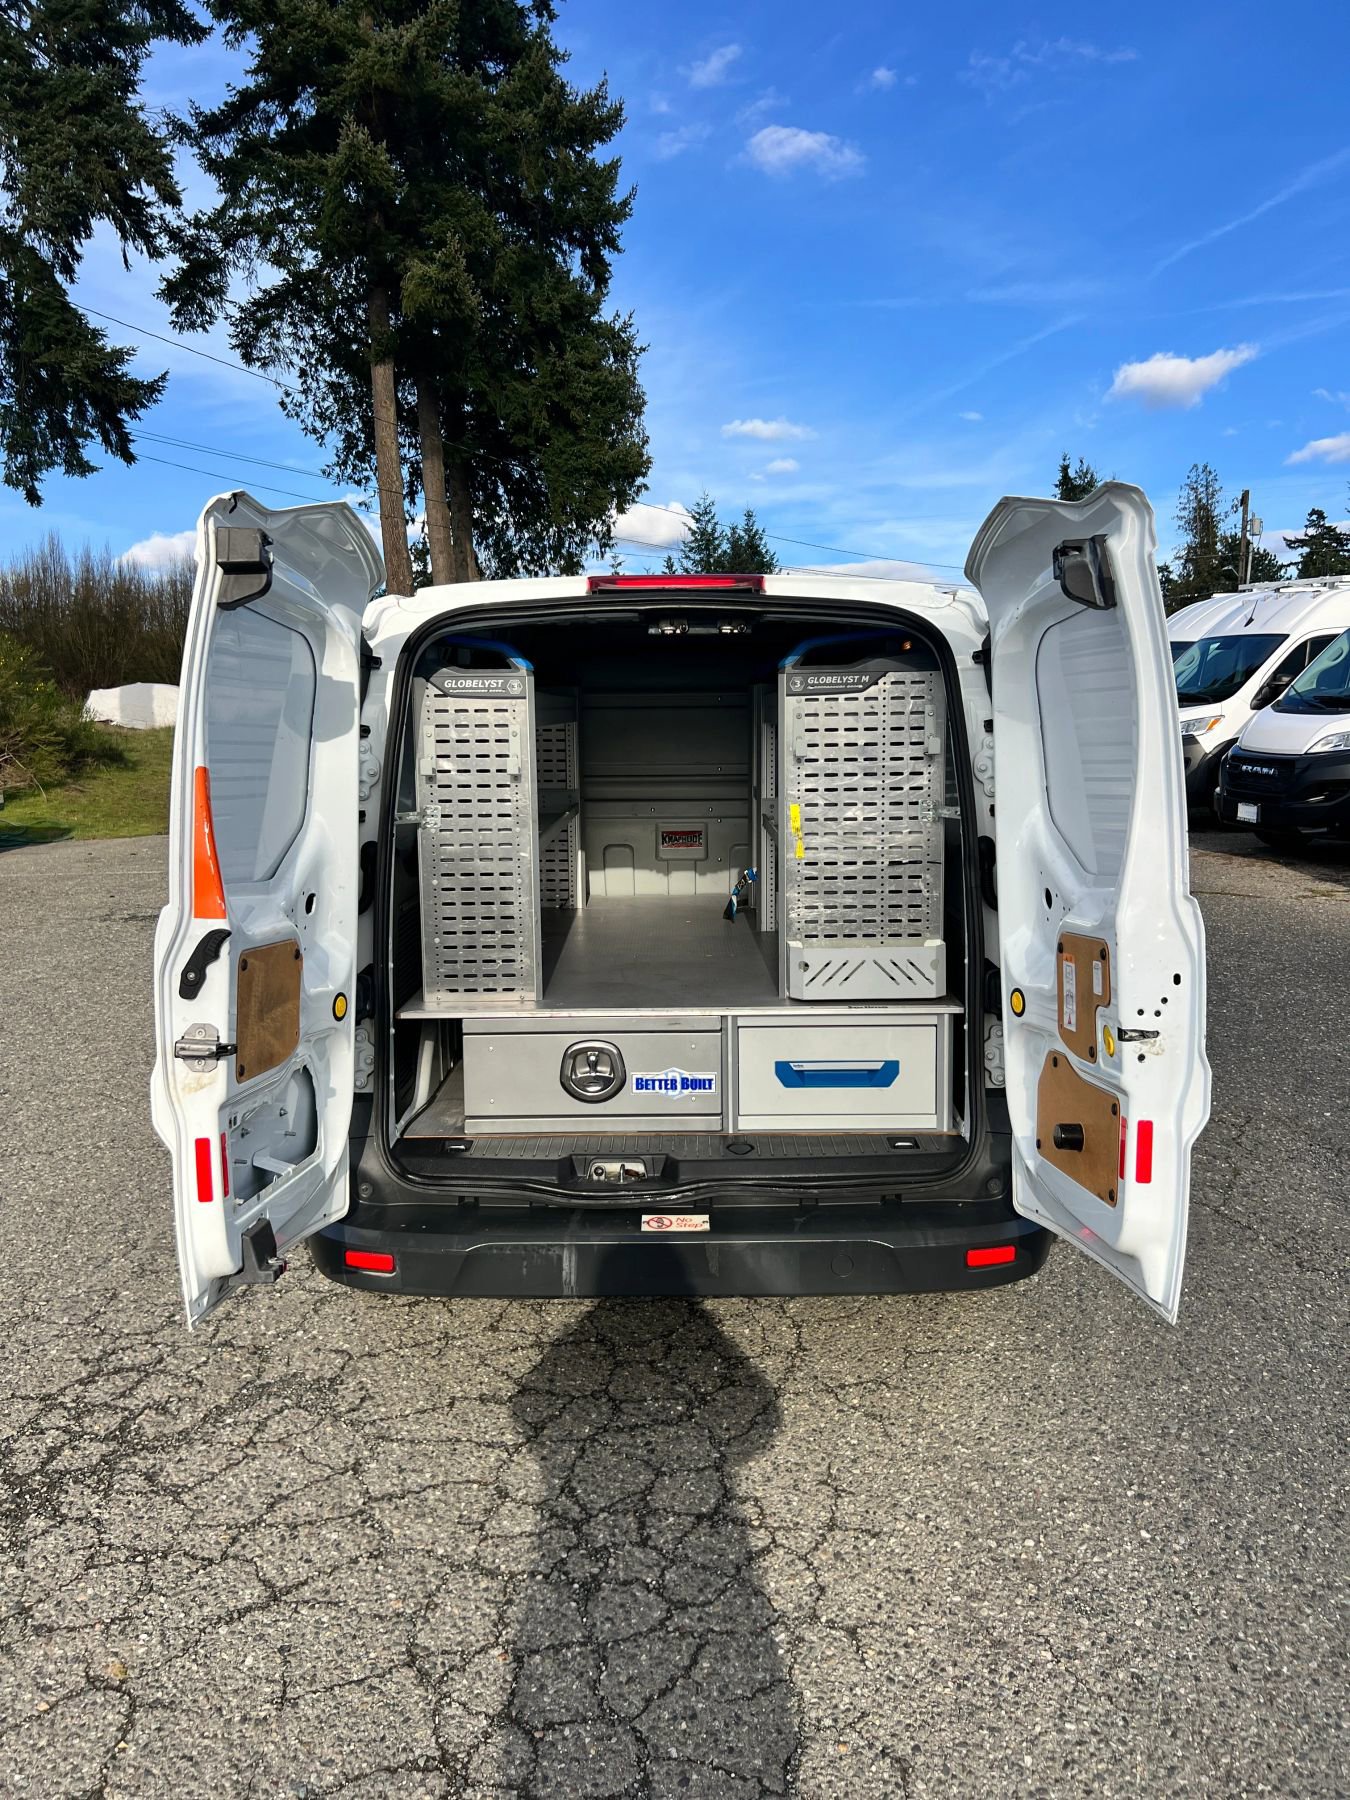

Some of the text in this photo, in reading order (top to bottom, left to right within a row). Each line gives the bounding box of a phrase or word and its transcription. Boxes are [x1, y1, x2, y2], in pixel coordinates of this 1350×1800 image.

[444, 679, 505, 688] GLOBELYST
[807, 675, 860, 684] GLOBELYST
[861, 675, 870, 683] M
[1241, 765, 1277, 775] RAM
[635, 1077, 714, 1091] BETTER BUILT
